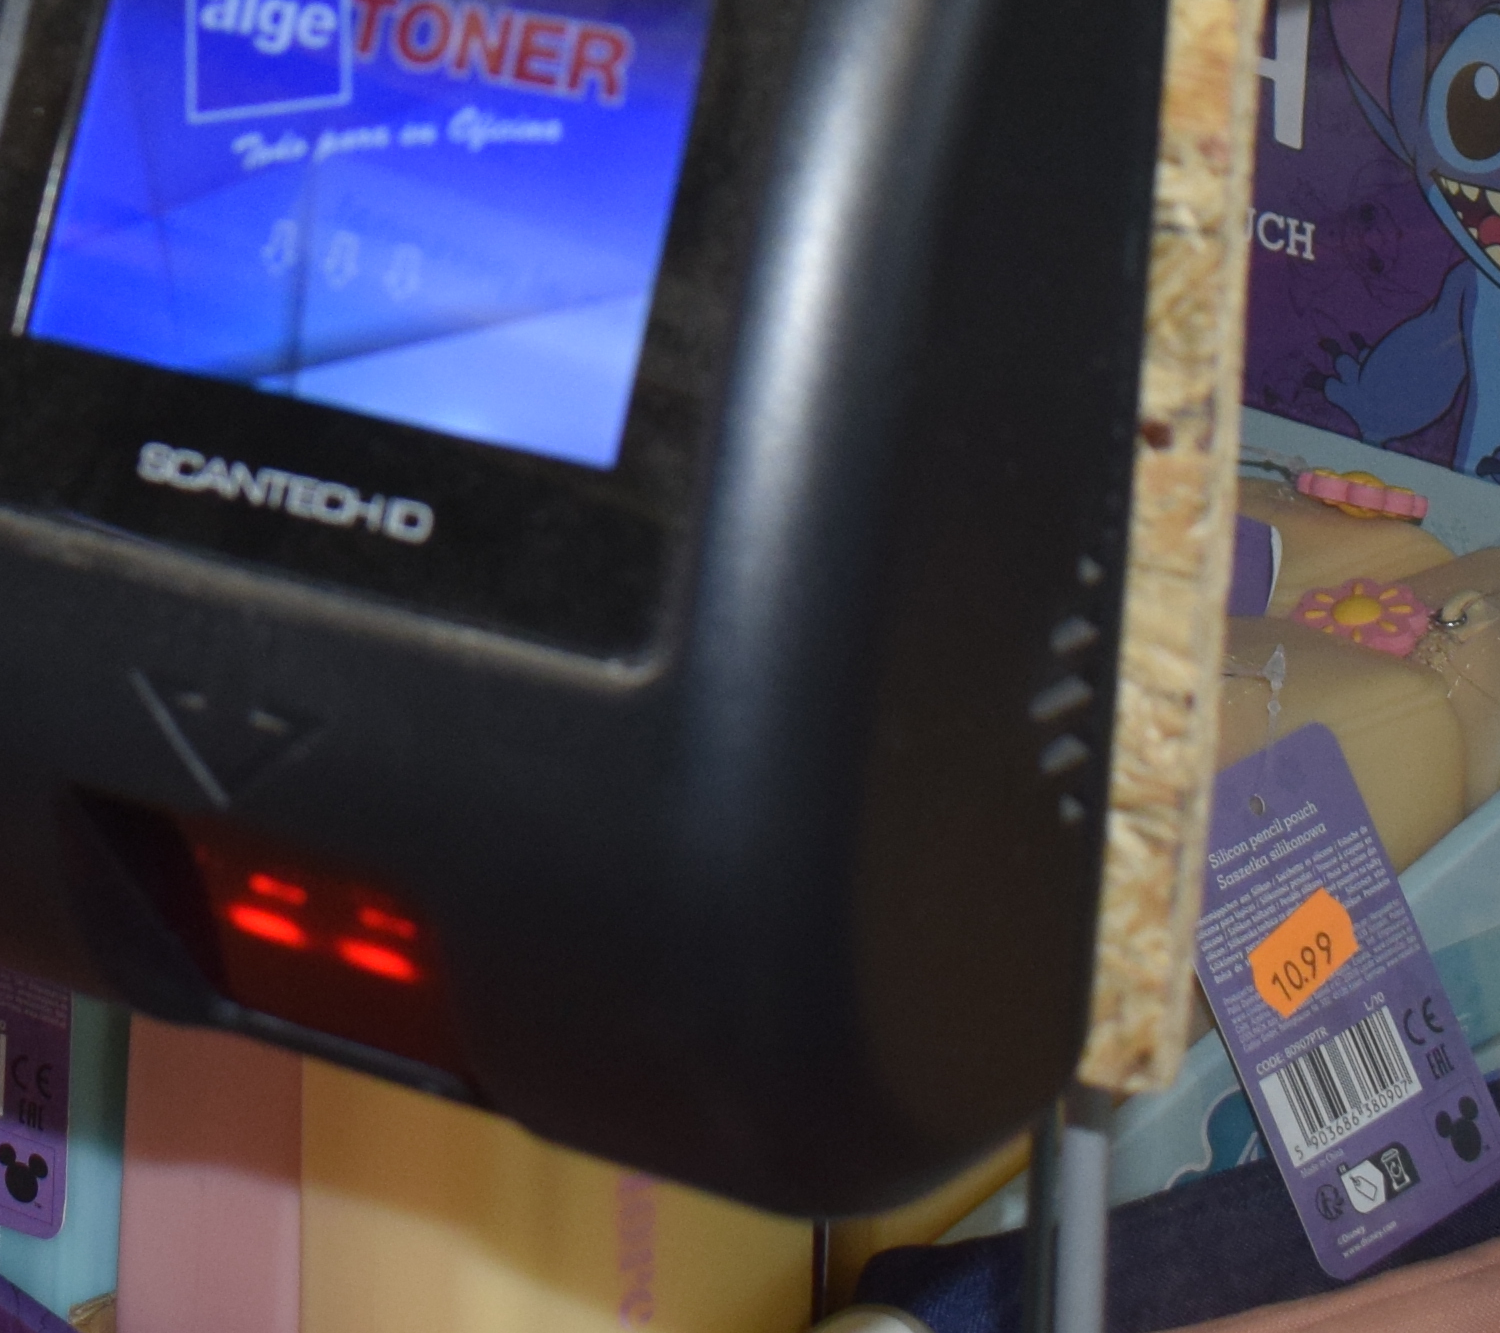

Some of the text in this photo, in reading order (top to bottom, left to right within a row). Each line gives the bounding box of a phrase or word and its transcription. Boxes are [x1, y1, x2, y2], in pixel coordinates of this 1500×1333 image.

[1208, 800, 1319, 870] Silicon pencil pouch
[1216, 822, 1327, 891] Saszetka silikonowa
[1271, 931, 1332, 1001] 10.99
[1255, 1055, 1284, 1075] CODE:
[1284, 1026, 1329, 1058] 80907PTR
[1293, 1079, 1412, 1161] 5 903686 380907
